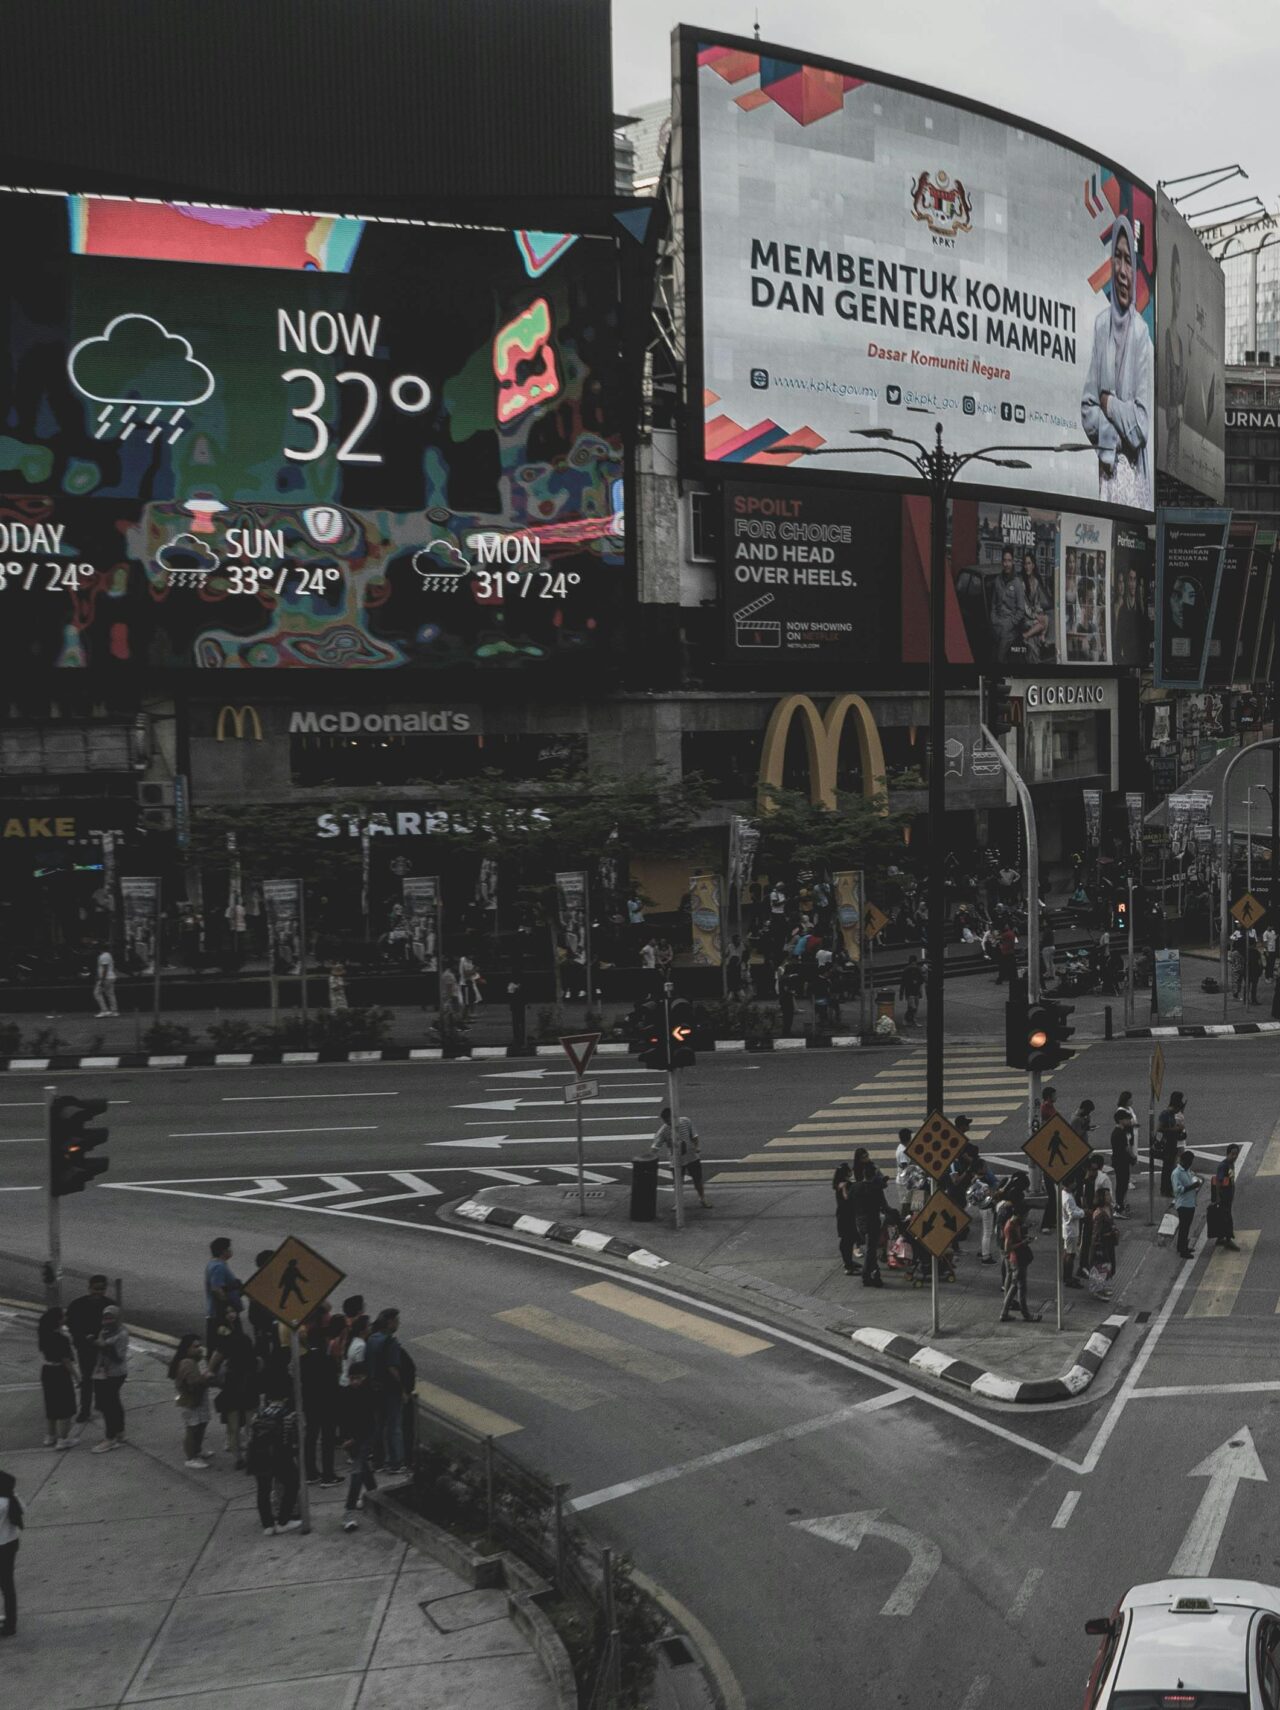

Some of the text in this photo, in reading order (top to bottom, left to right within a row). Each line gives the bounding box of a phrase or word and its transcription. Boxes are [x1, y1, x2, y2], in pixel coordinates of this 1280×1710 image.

[932, 235, 956, 249] KPKT
[750, 238, 1076, 333] MEMBENTUK KOMUNITI
[750, 276, 1076, 364] DAN GENERASI MAMPAN
[277, 308, 381, 357] NOW
[867, 343, 1011, 381] Dasar Komuniti Negara
[774, 376, 879, 401] www.kpkt.gov.my
[281, 368, 432, 464] 32°
[734, 495, 802, 517] SPOILT
[734, 518, 852, 544] FOR CHOICE
[1001, 513, 1032, 531] ALWAYS
[225, 528, 285, 560] SUN
[1010, 529, 1036, 546] MAYBE
[476, 535, 542, 564] MON
[734, 542, 835, 563] AND HEAD
[734, 565, 857, 587] OVER HEELS.
[786, 622, 853, 632] NOW SHOWING
[787, 632, 801, 640] ON
[1027, 685, 1104, 706] GIORDANO
[289, 711, 471, 733] McDonald's
[3, 816, 77, 838] AKE
